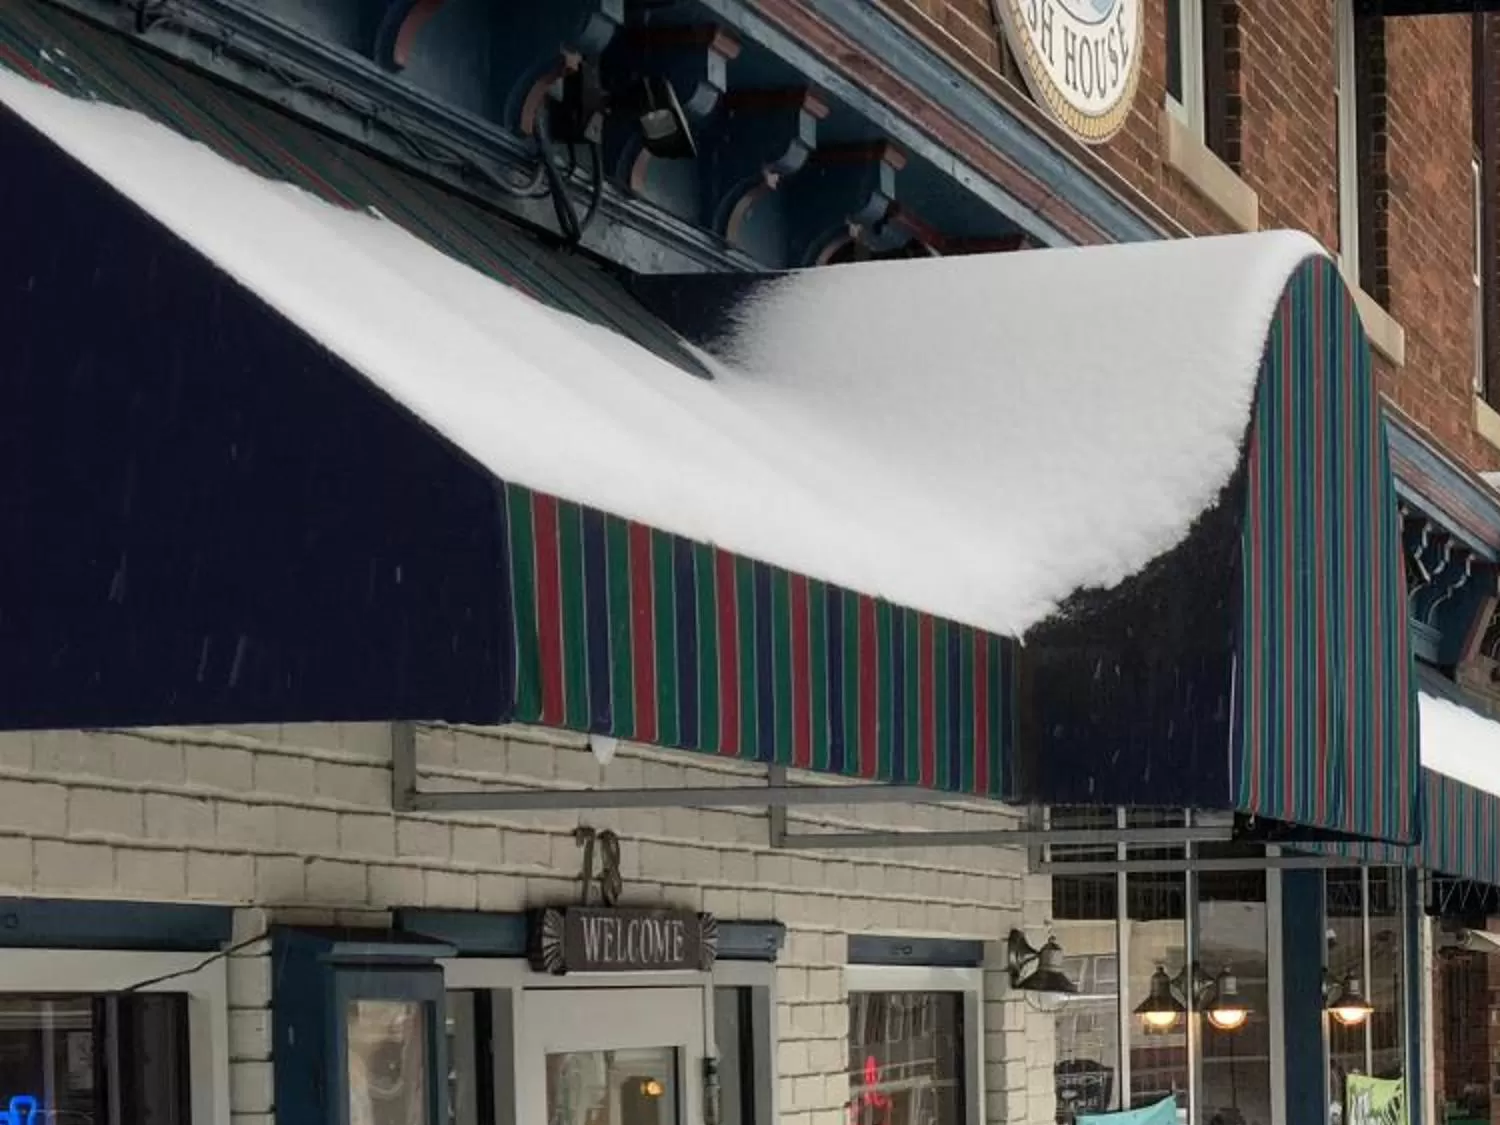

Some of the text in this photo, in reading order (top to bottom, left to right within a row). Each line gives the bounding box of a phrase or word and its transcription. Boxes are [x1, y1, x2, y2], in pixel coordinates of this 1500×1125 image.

[1063, 2, 1129, 99] HOUSE
[573, 826, 622, 907] 78
[580, 916, 685, 963] WELCOME
